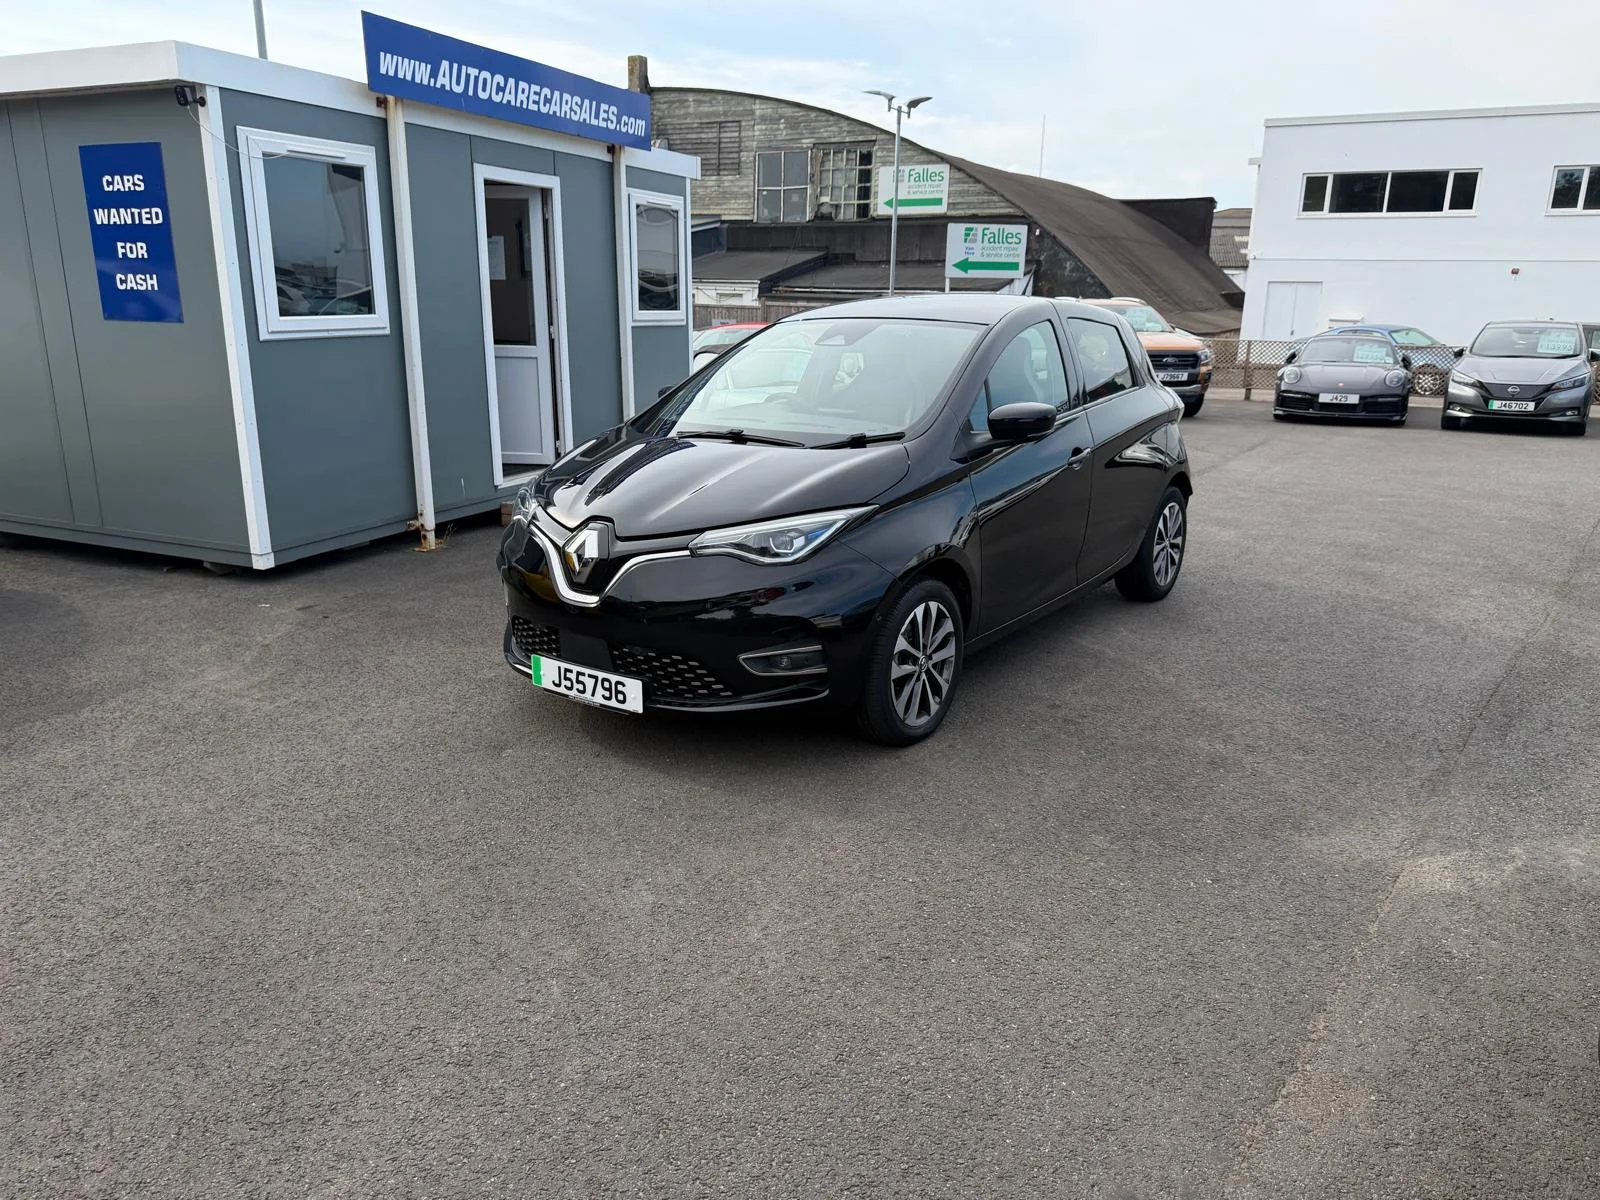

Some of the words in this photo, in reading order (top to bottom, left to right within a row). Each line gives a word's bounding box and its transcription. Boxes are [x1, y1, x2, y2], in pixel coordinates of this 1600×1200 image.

[379, 51, 646, 137] www.AUTOCARECARSALES.com
[102, 174, 145, 191] CARS
[907, 168, 944, 183] Falles
[93, 207, 164, 225] WANTED
[981, 227, 1022, 245] Falles
[116, 241, 148, 259] FOR
[115, 273, 158, 291] CASH
[1329, 394, 1349, 402] J429
[1496, 401, 1529, 410] J46702
[552, 665, 627, 704] J55796
